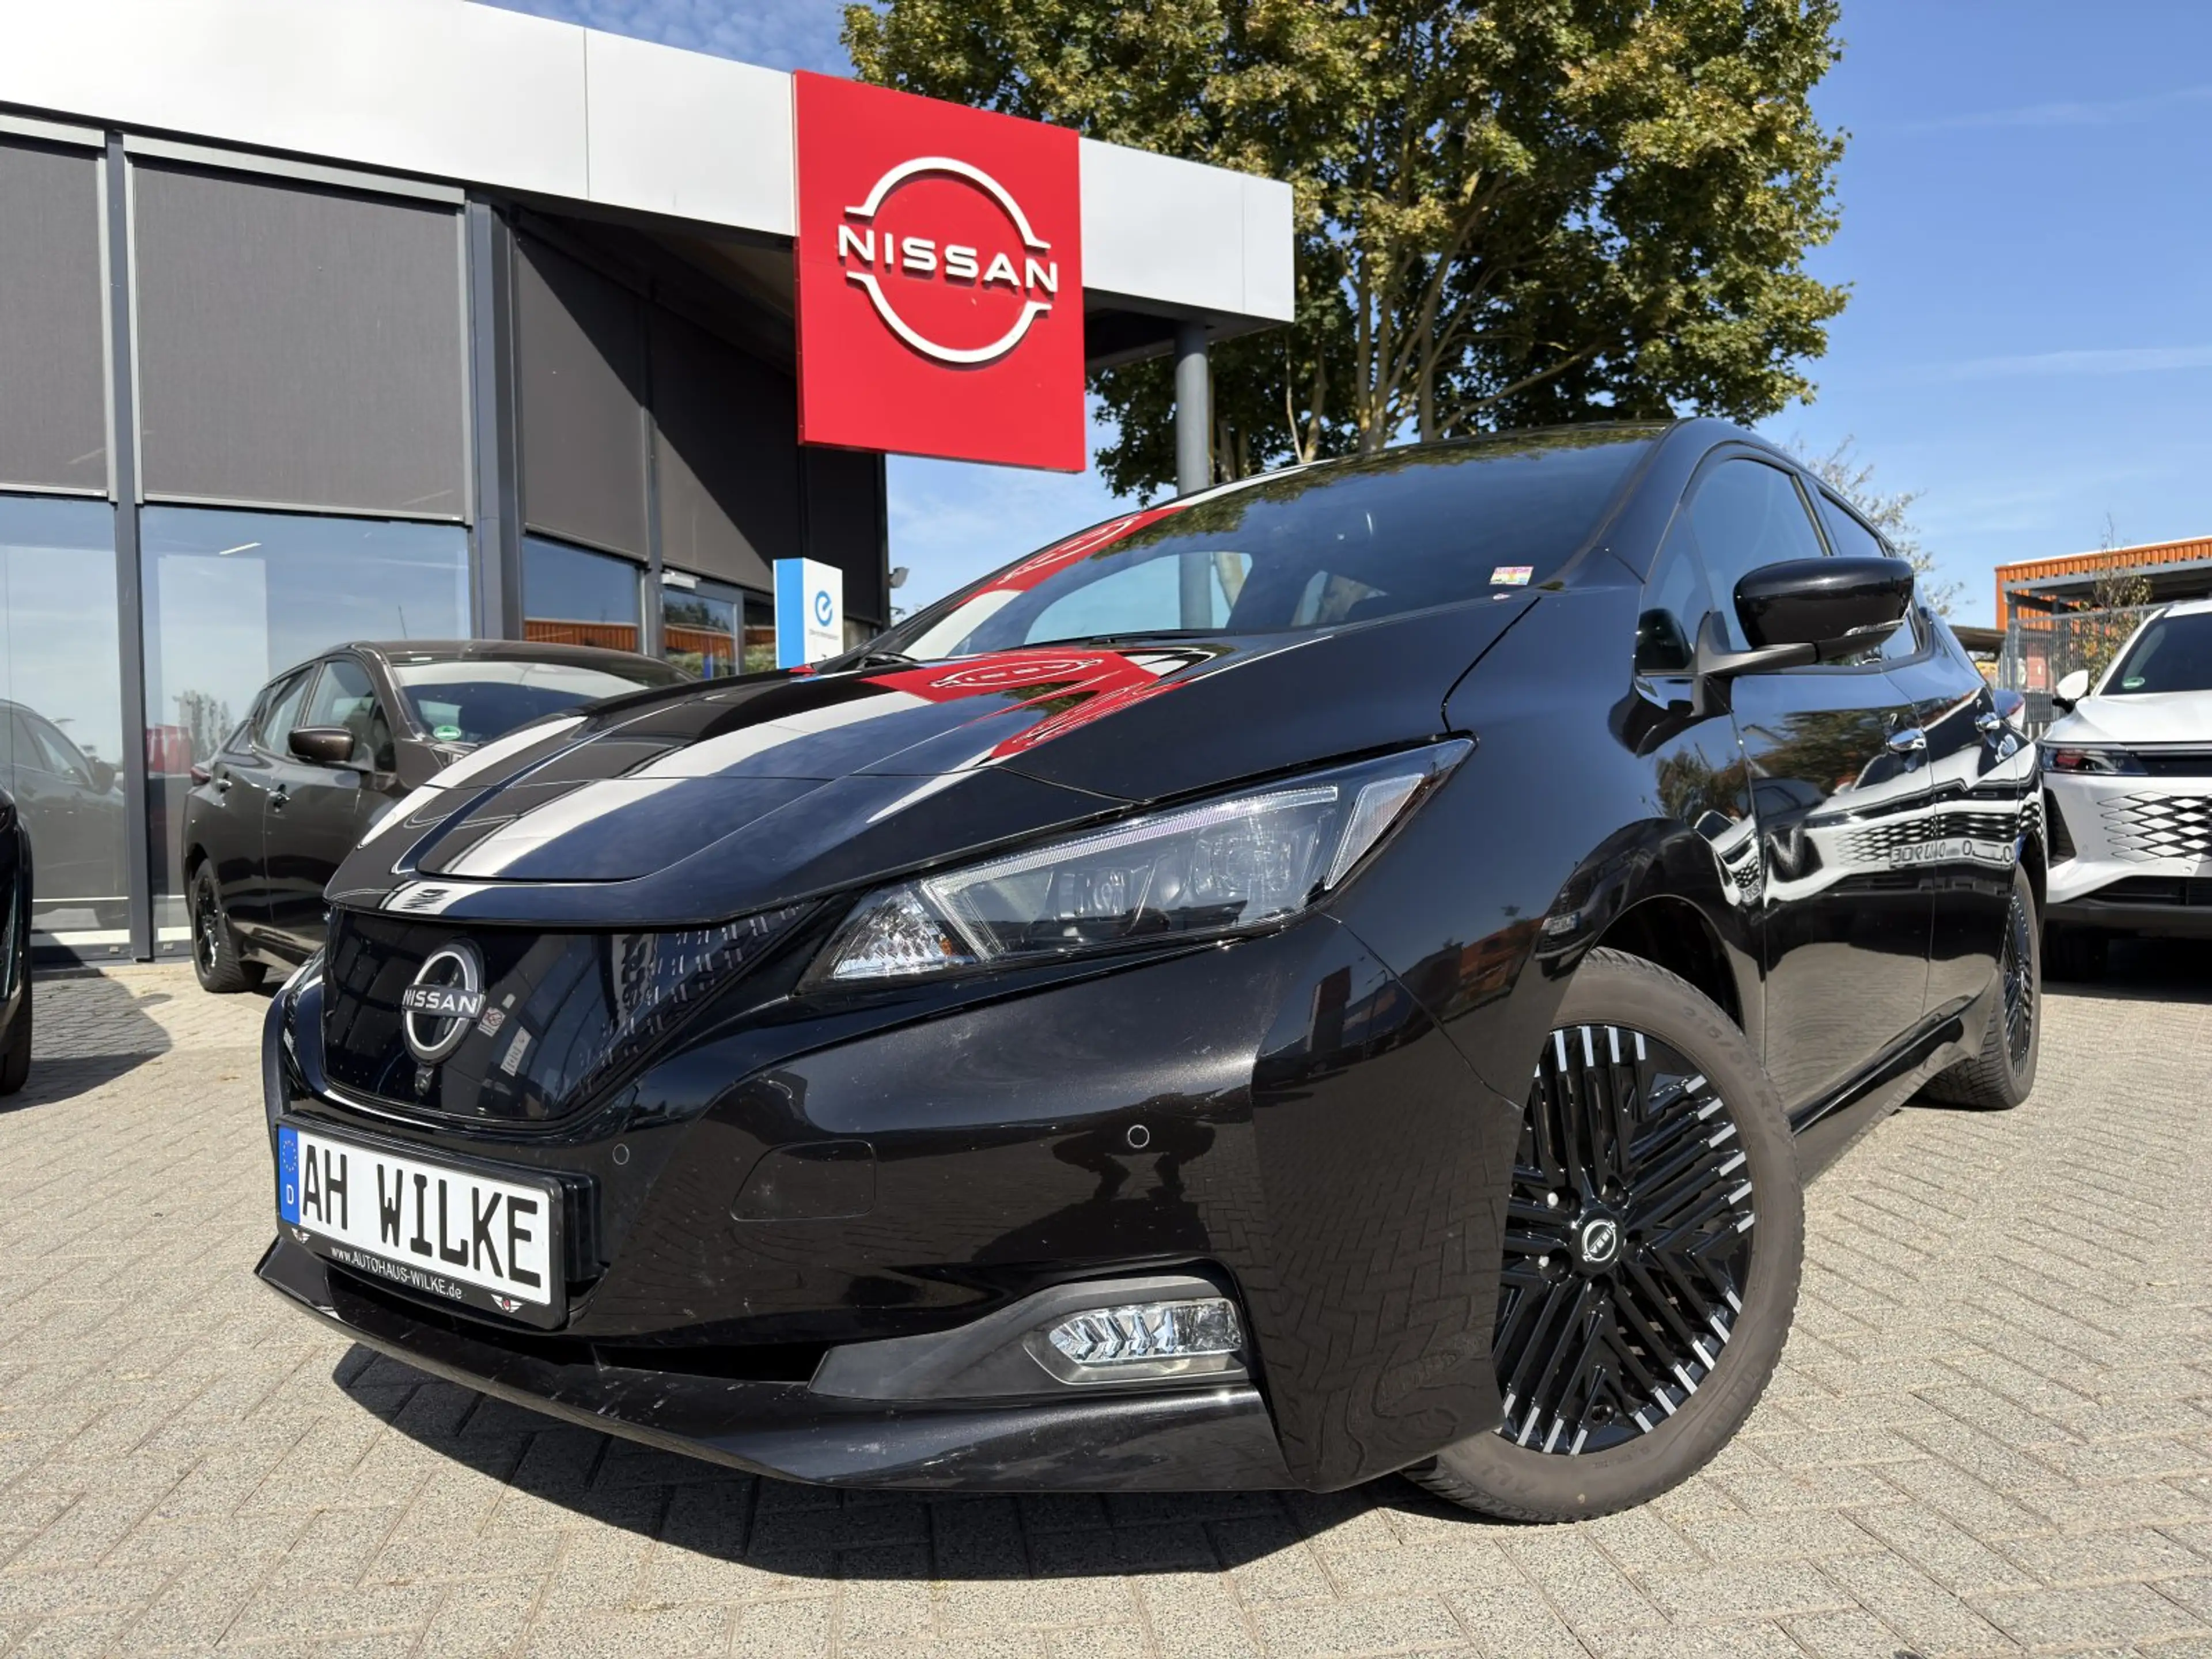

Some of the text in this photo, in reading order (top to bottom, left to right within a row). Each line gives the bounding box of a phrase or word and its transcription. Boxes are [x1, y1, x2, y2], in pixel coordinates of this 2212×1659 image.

[838, 224, 1058, 293] NISSAN
[402, 988, 478, 1015] NISSAN
[286, 1184, 294, 1205] D
[302, 1144, 541, 1289] AH WILKE
[330, 1246, 463, 1300] www.AUTOHAUS-WILKE.de
